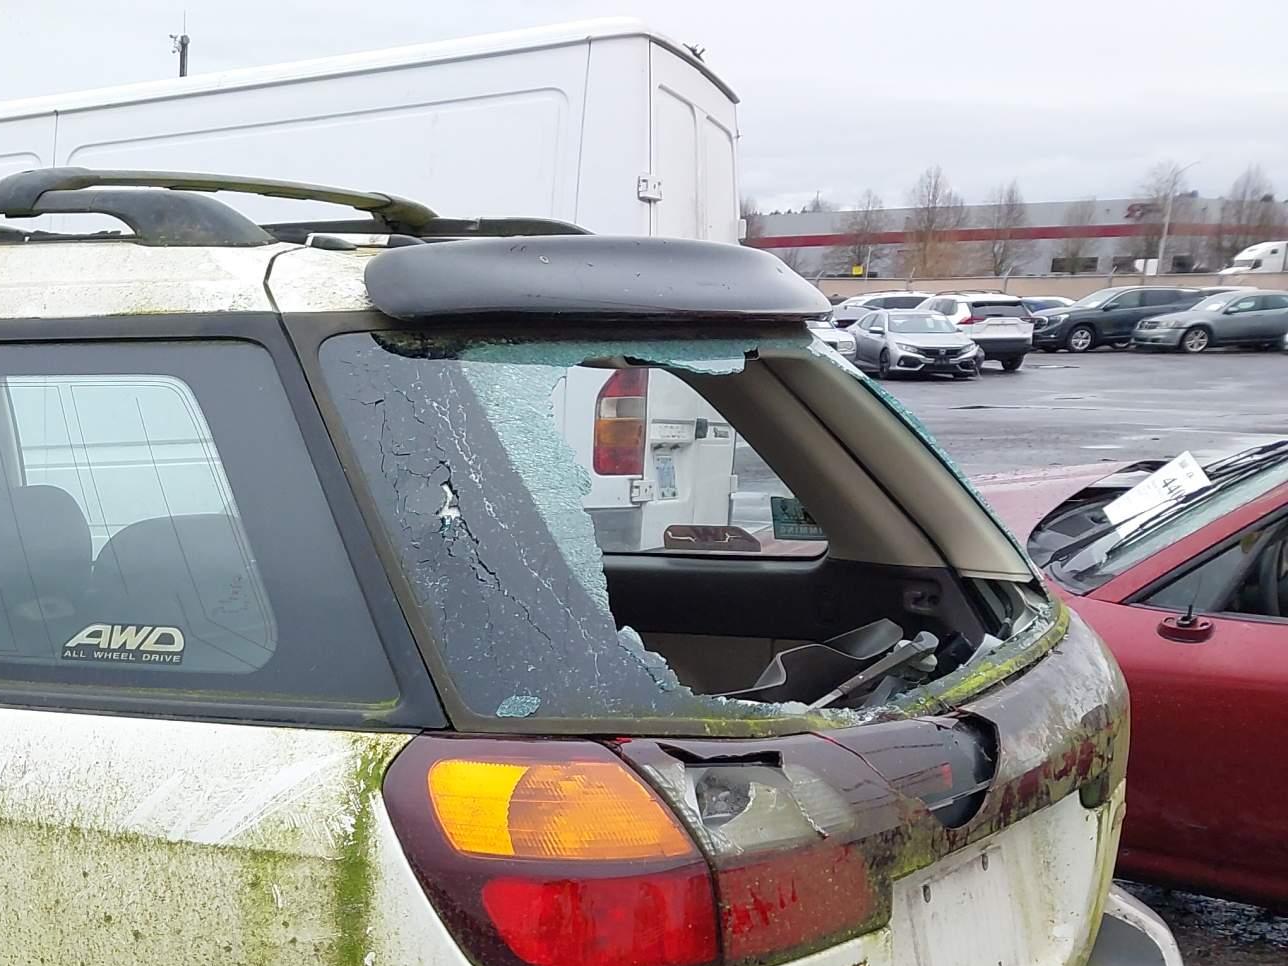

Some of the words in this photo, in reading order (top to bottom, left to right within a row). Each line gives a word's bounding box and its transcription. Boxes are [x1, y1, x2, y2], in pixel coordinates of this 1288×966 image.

[65, 624, 185, 652] AWD
[64, 650, 86, 658] ALL
[93, 651, 136, 661] WHEEL
[142, 654, 181, 663] DRIVE
